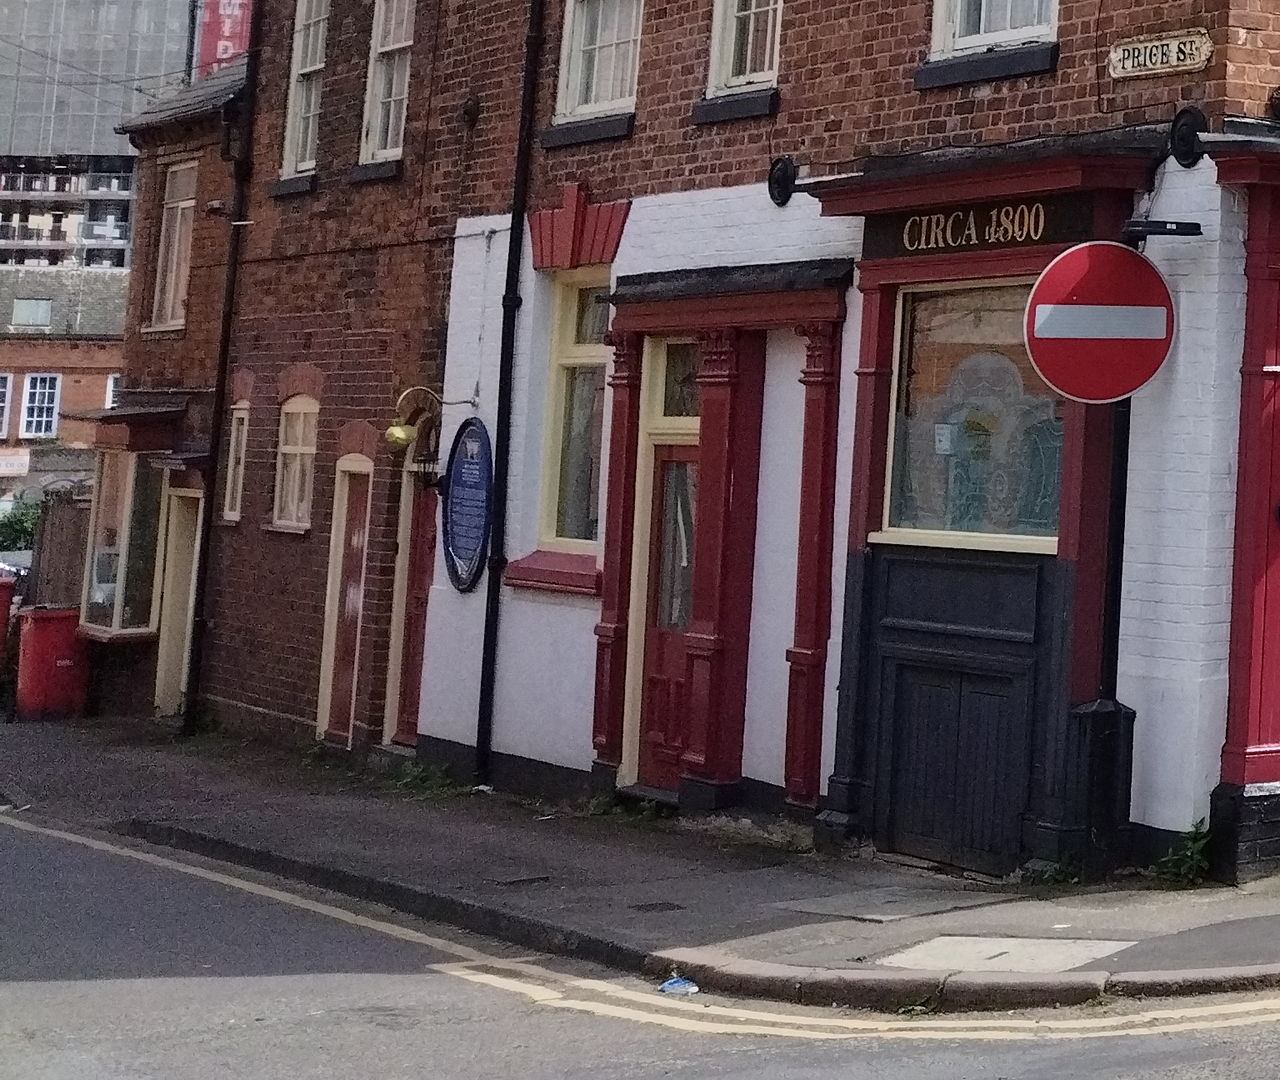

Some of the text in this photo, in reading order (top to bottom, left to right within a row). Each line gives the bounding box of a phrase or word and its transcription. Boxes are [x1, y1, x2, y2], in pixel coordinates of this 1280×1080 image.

[1121, 44, 1170, 69] PRICE
[903, 203, 1045, 250] CIRCA 1800
